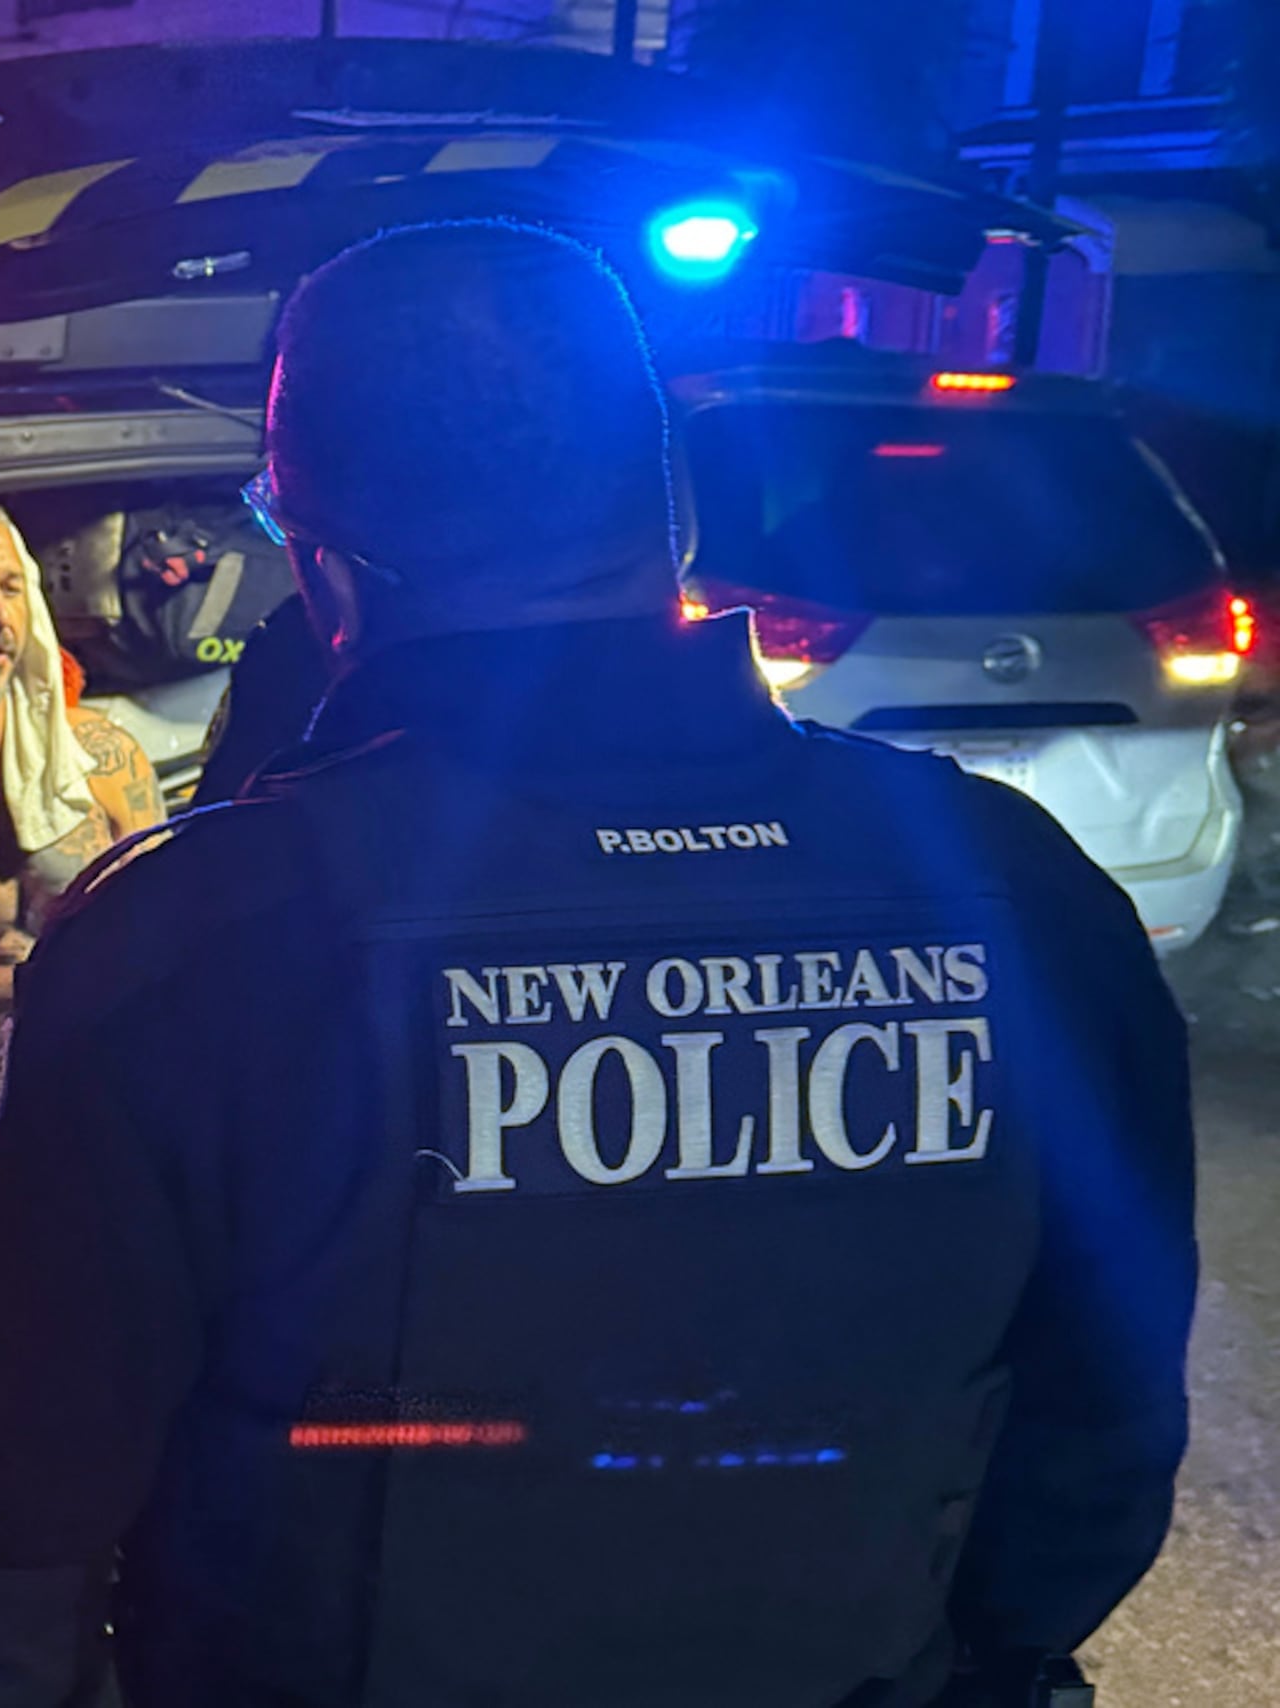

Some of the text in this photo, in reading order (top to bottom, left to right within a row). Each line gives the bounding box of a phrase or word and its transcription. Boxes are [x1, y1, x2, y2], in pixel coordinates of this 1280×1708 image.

[596, 822, 788, 854] P.BOLTON
[442, 944, 988, 1026] NEW ORLEANS
[451, 1017, 994, 1193] POLICE
